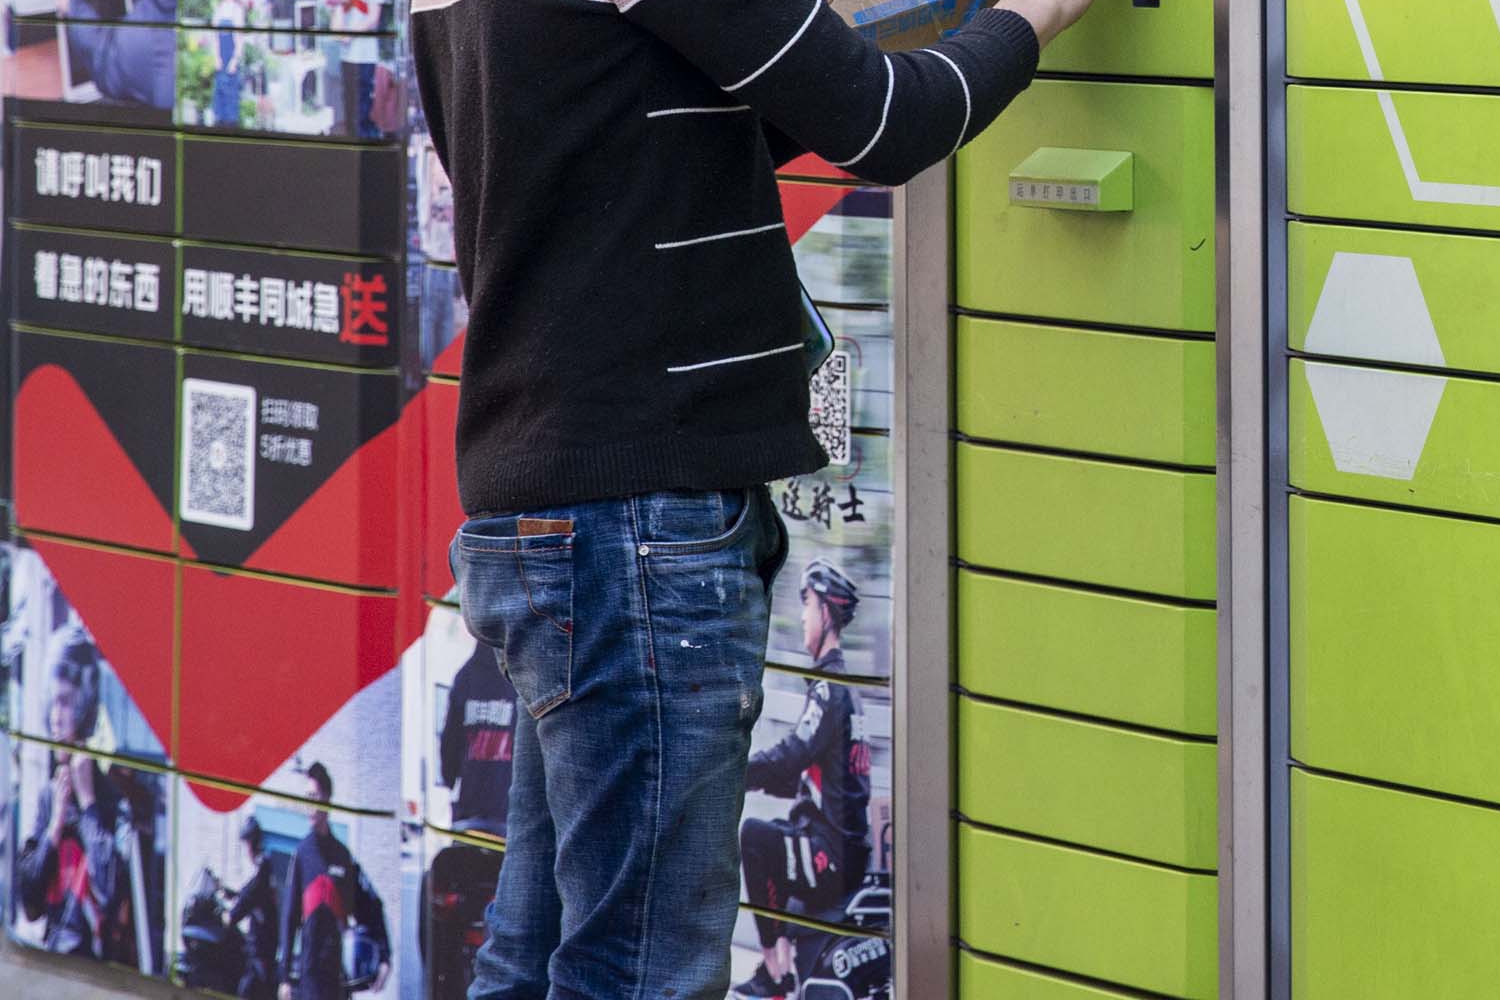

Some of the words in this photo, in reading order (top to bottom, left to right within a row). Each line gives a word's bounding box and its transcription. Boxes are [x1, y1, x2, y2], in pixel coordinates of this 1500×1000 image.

[34, 147, 162, 206] 请呼叫我们
[34, 250, 160, 313] 着急的东西
[182, 258, 389, 346] 用顺丰同城急送
